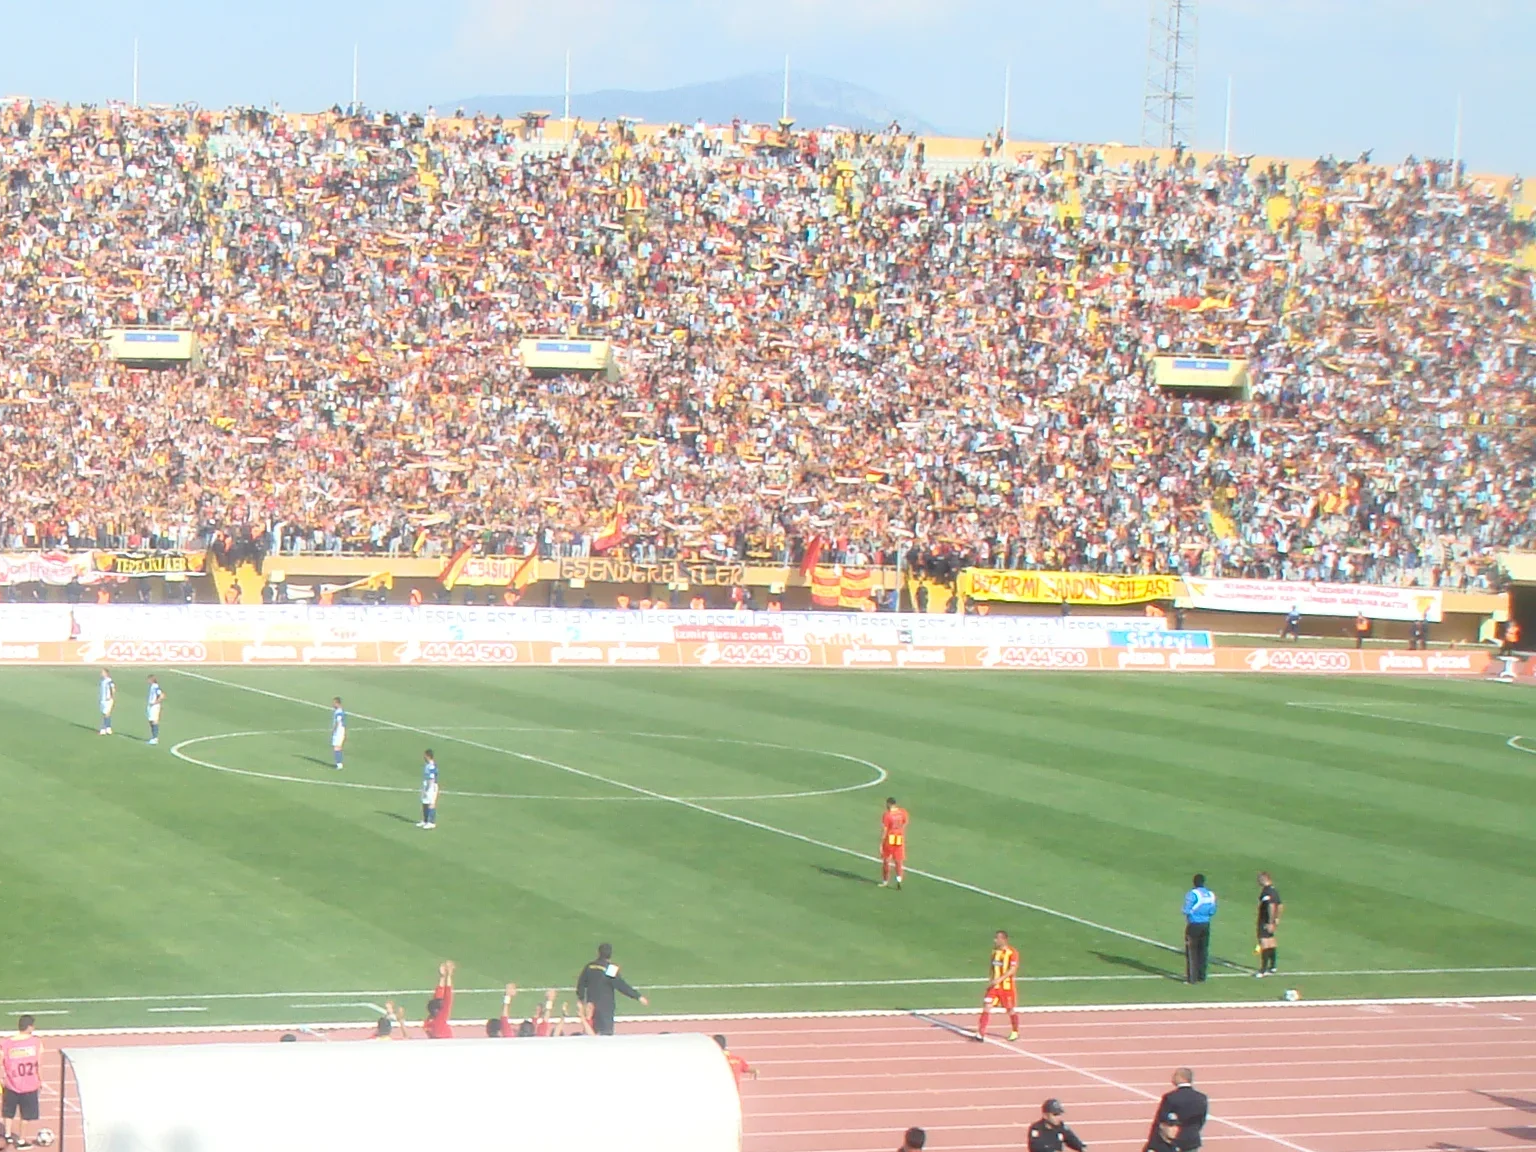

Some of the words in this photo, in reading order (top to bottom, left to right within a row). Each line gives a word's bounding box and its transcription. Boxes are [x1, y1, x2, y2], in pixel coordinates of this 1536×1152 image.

[168, 643, 204, 659] 500
[480, 643, 514, 659] 500
[776, 645, 808, 662] 500
[1056, 649, 1085, 664] 500
[1319, 653, 1348, 668] 500
